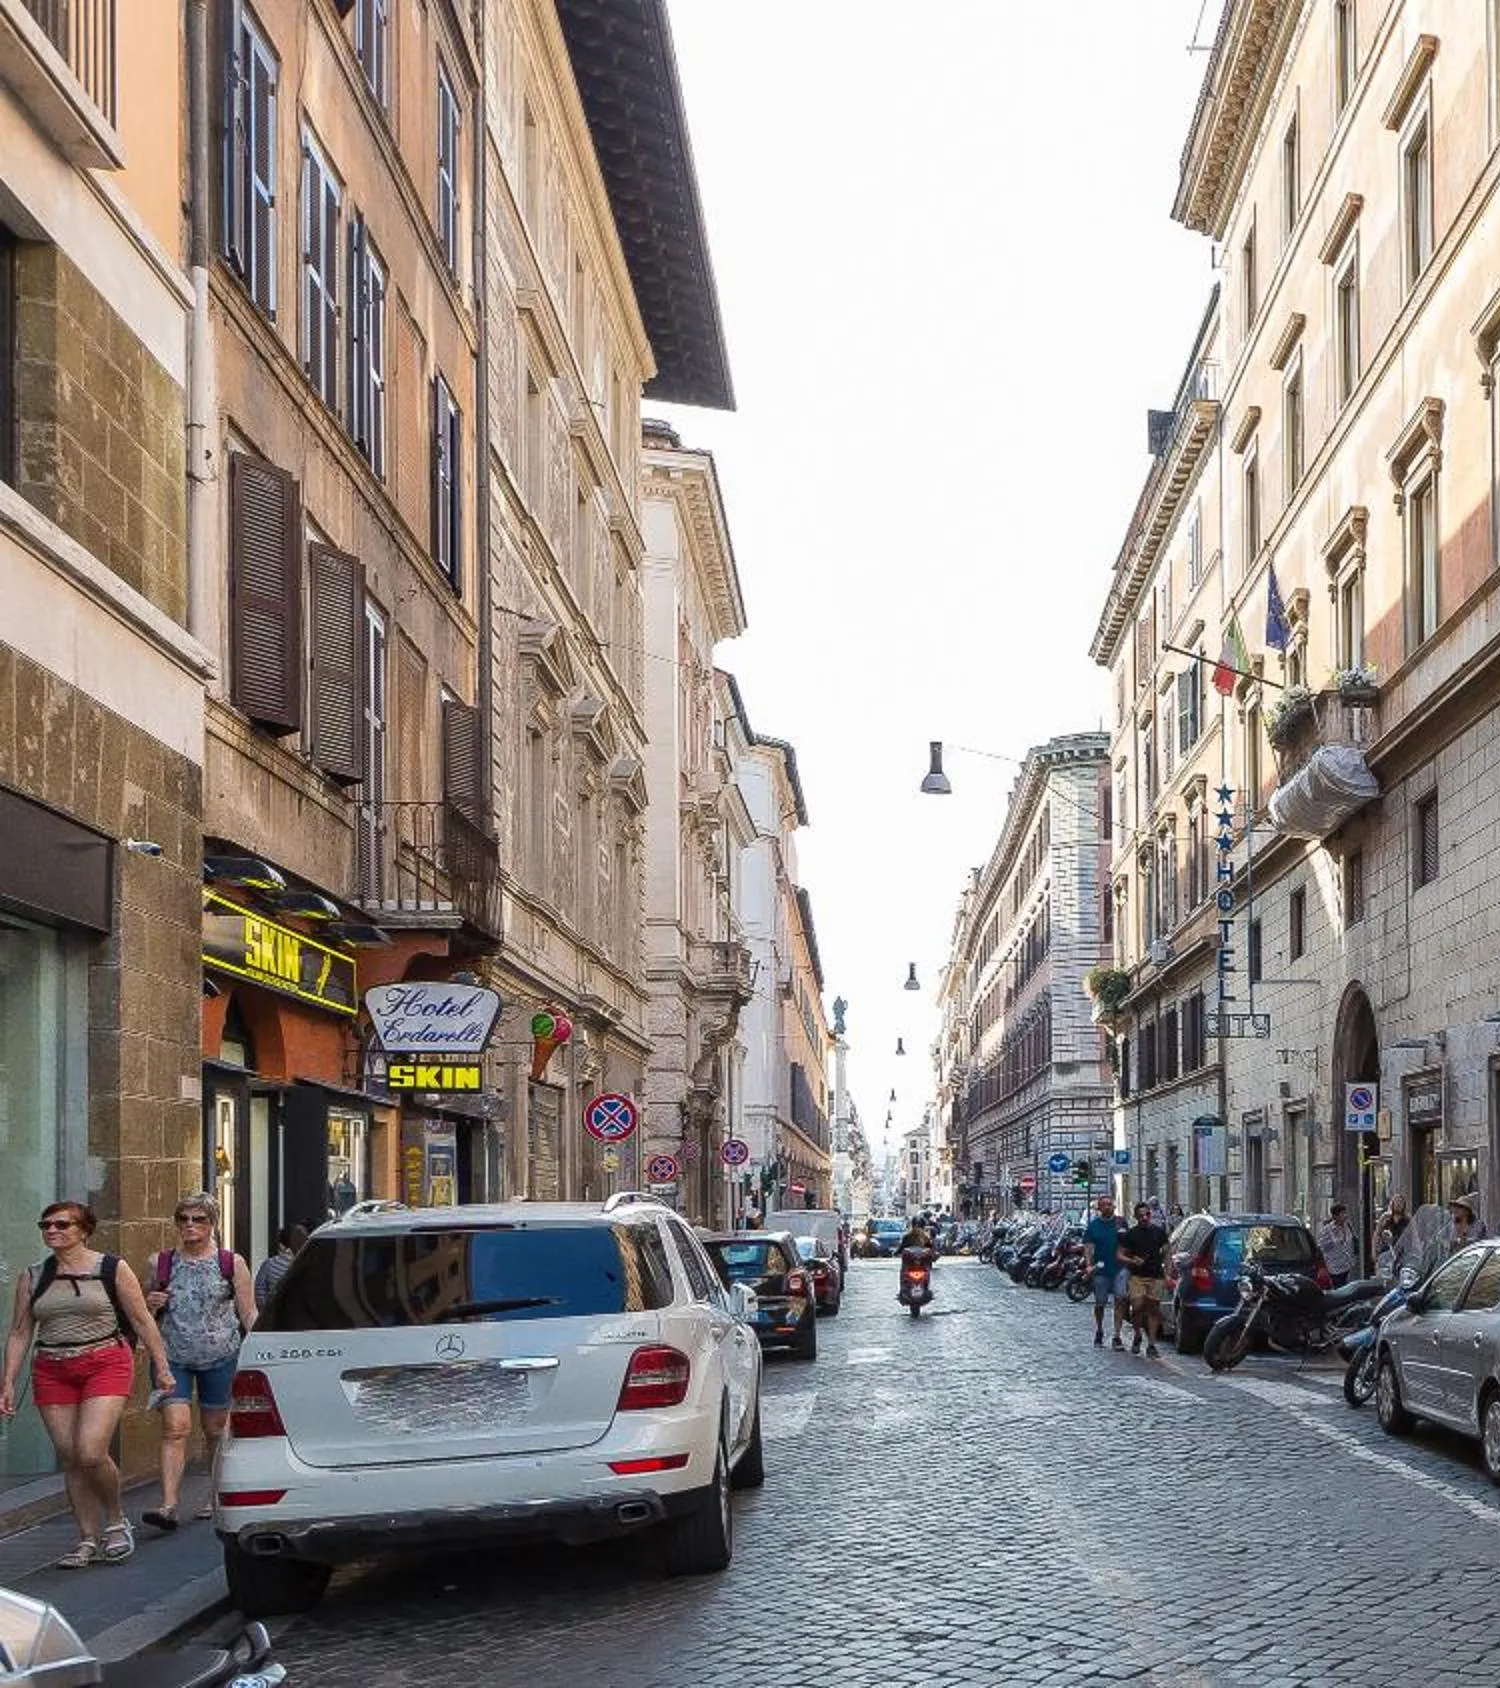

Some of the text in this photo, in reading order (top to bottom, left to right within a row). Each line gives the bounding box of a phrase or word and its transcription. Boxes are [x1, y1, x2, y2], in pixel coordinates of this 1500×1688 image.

[1216, 861, 1236, 1002] HOTEL
[243, 916, 300, 983] SKIN
[376, 987, 485, 1018] Hotel
[383, 1018, 485, 1044] Erdarelli
[388, 1064, 481, 1090] SKIN
